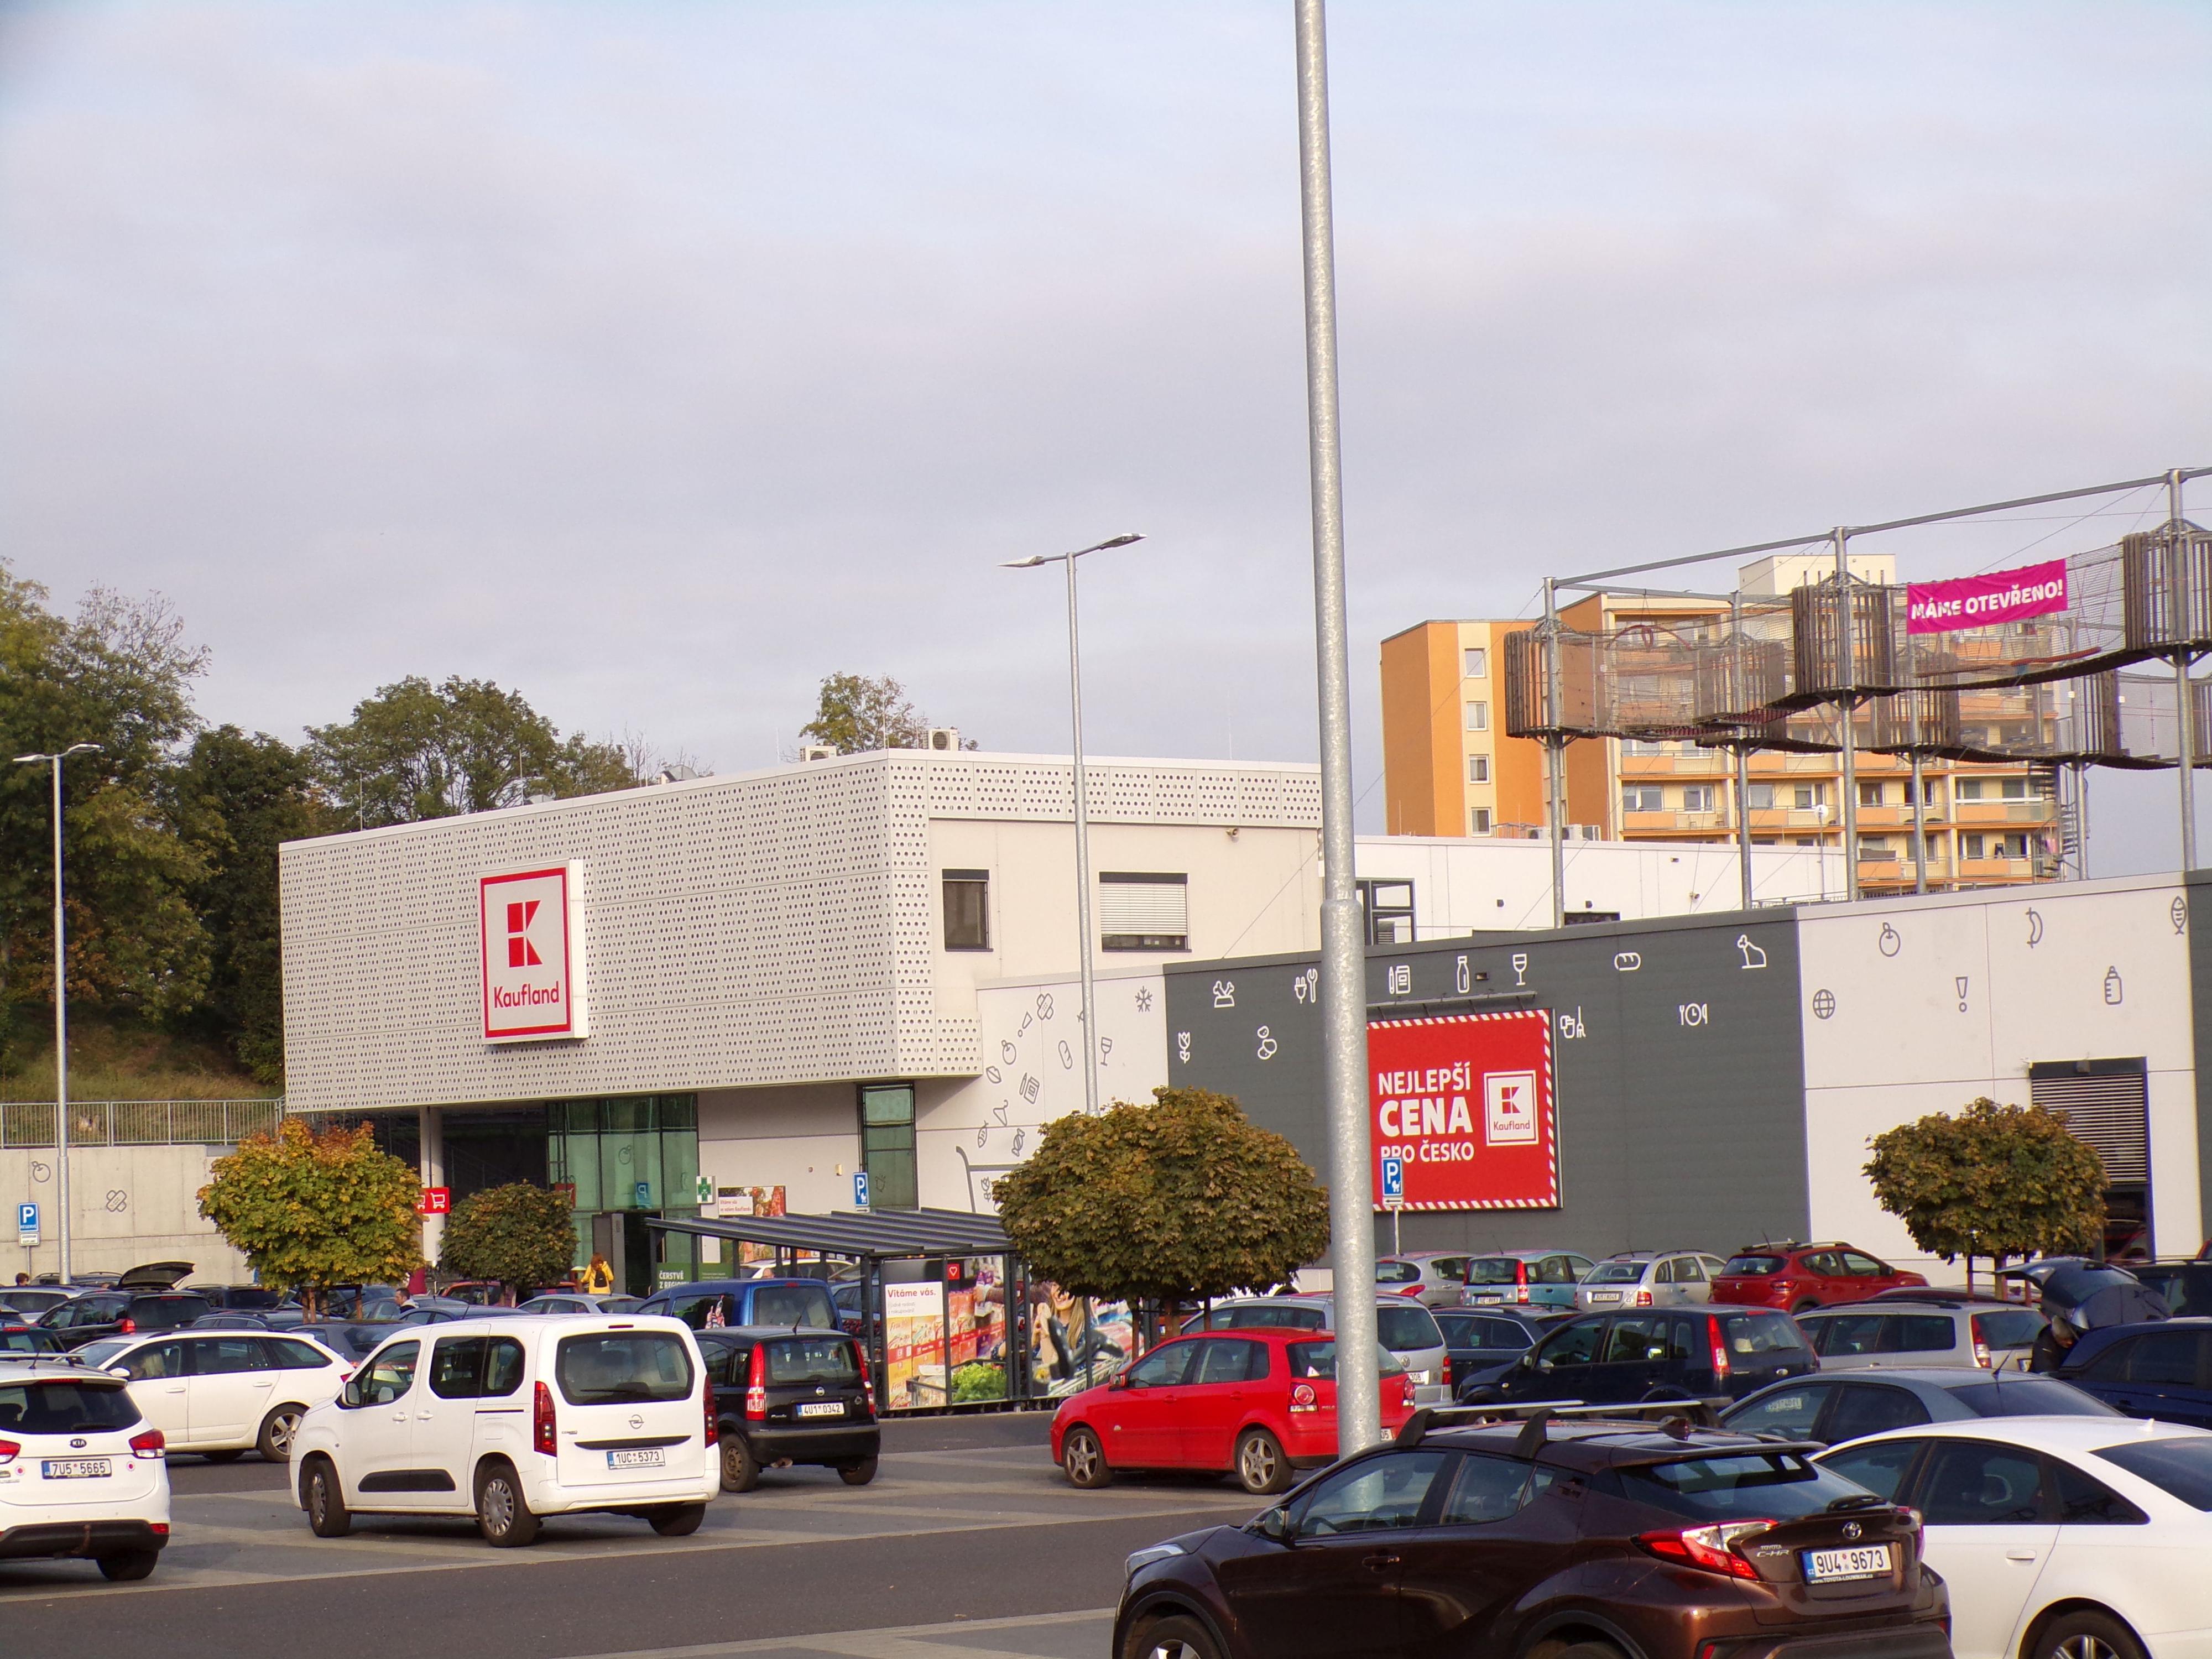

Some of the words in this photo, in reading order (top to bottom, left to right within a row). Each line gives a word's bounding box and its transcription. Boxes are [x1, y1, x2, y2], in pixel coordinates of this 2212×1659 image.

[1911, 597, 1962, 620] MÁME
[1965, 579, 2063, 614] OTEVŘENO!
[494, 980, 560, 1009] Kaufland
[1379, 1061, 1471, 1095] NEJLEPŠÍ
[1379, 1096, 1473, 1138] CENA
[1493, 1120, 1531, 1131] Kaufland
[1420, 1139, 1474, 1162] ČESKO
[1386, 1162, 1399, 1185] P
[857, 1177, 865, 1196] P
[23, 1206, 34, 1223] P
[659, 1270, 684, 1280] ČERSTVÉ
[888, 1288, 917, 1298] Vítáme
[920, 1287, 936, 1296] vás.
[804, 1406, 818, 1415] 4U1
[823, 1405, 841, 1413] 0342
[617, 1453, 632, 1464] 1UC
[638, 1451, 660, 1462] 5373
[53, 1463, 72, 1475] 7U5
[80, 1462, 106, 1474] 5665
[1817, 1554, 1841, 1574] 9U4
[1851, 1550, 1884, 1571] 9673
